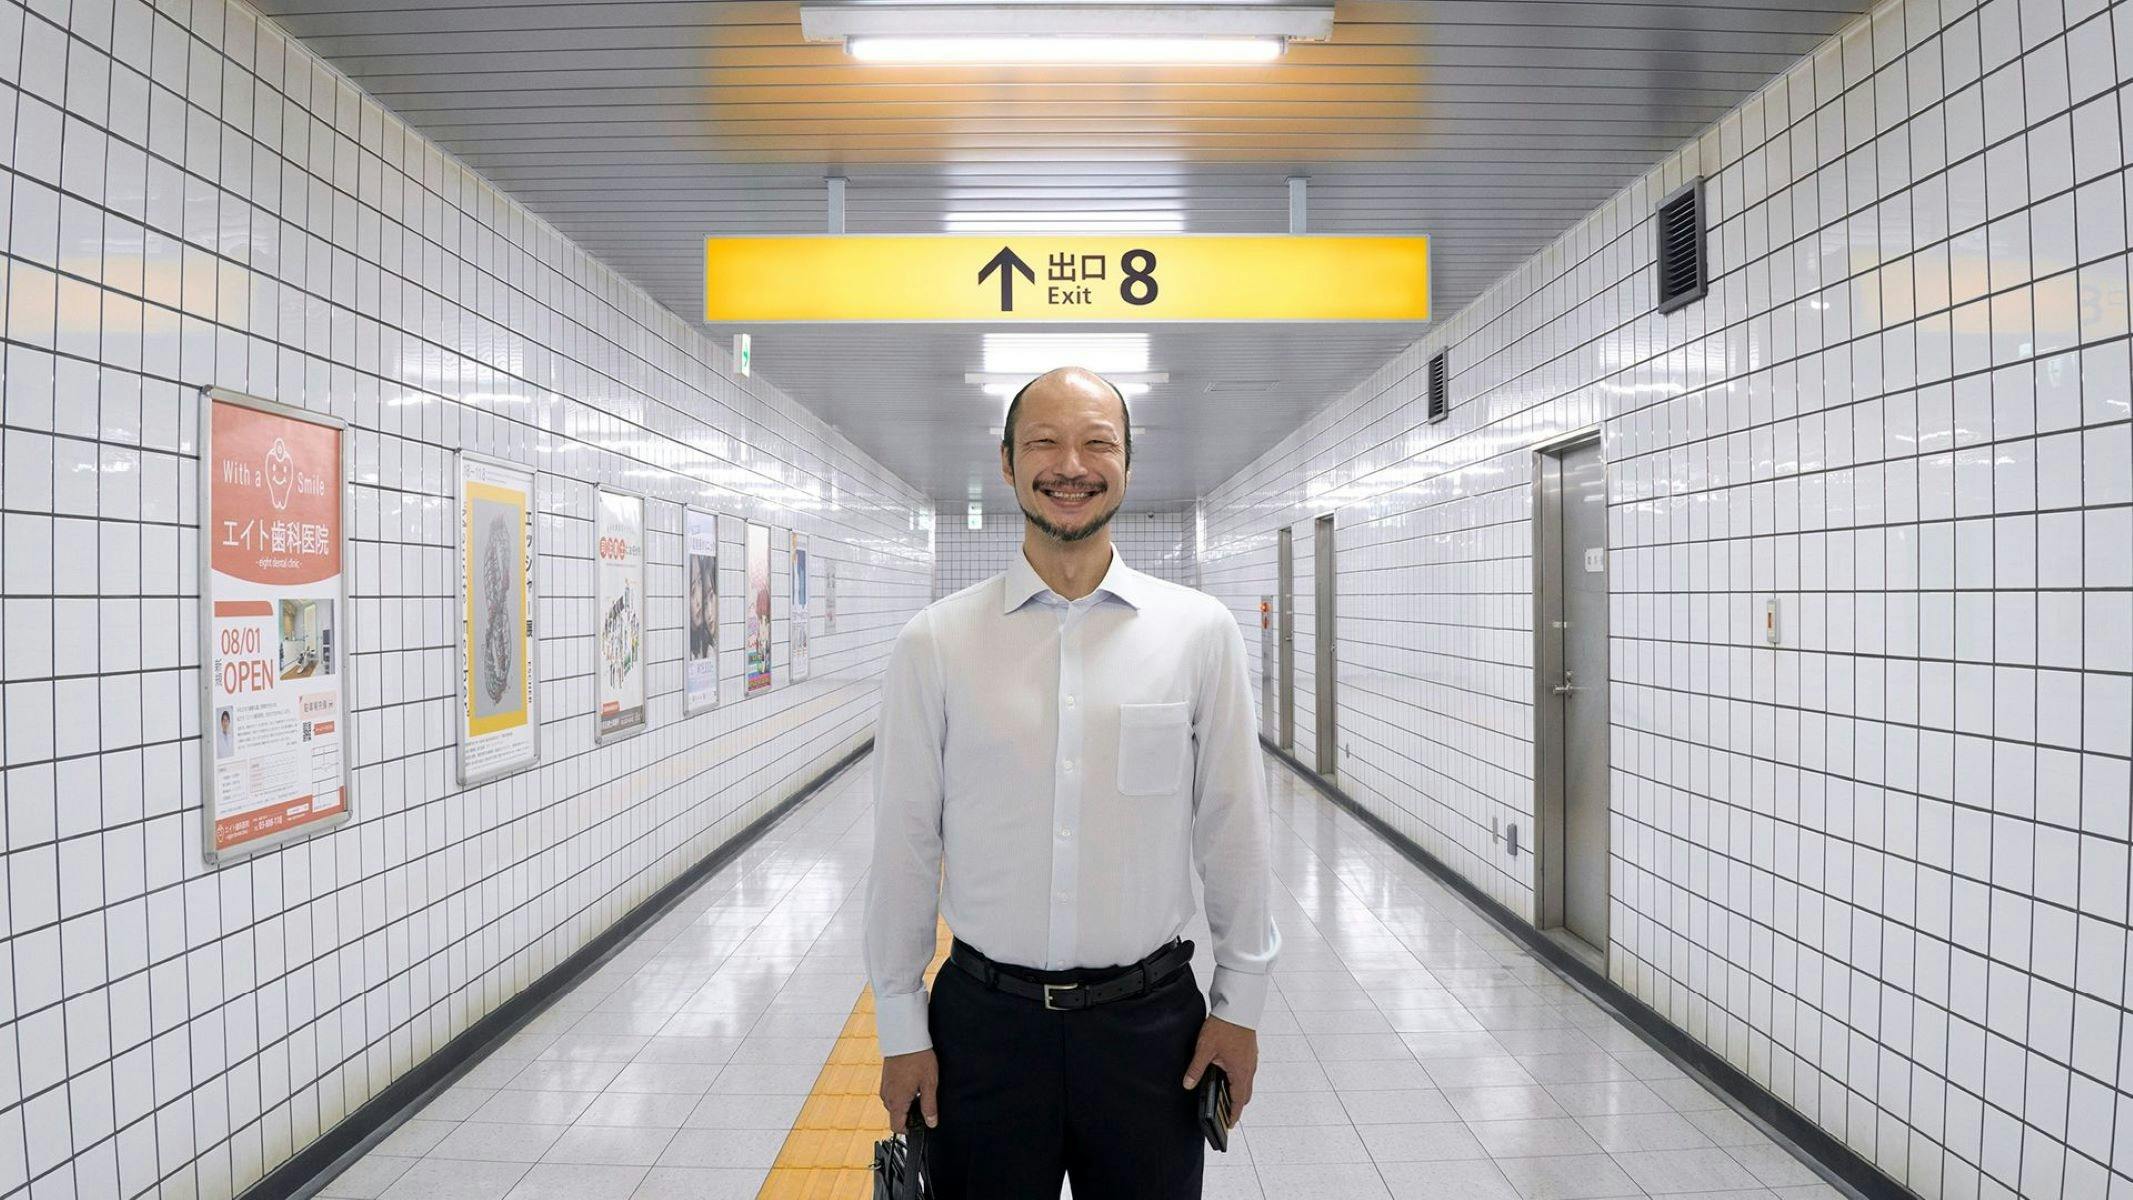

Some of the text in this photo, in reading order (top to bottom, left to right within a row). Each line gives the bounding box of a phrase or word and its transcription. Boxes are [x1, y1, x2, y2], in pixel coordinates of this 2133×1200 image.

[1048, 252, 1106, 282] 出口
[1119, 248, 1159, 306] 8
[1048, 285, 1092, 305] Exit
[223, 459, 325, 496] With a Smile
[222, 519, 330, 556] エイト歯科医院
[221, 627, 262, 656] 08/01
[224, 659, 274, 694] OPEN
